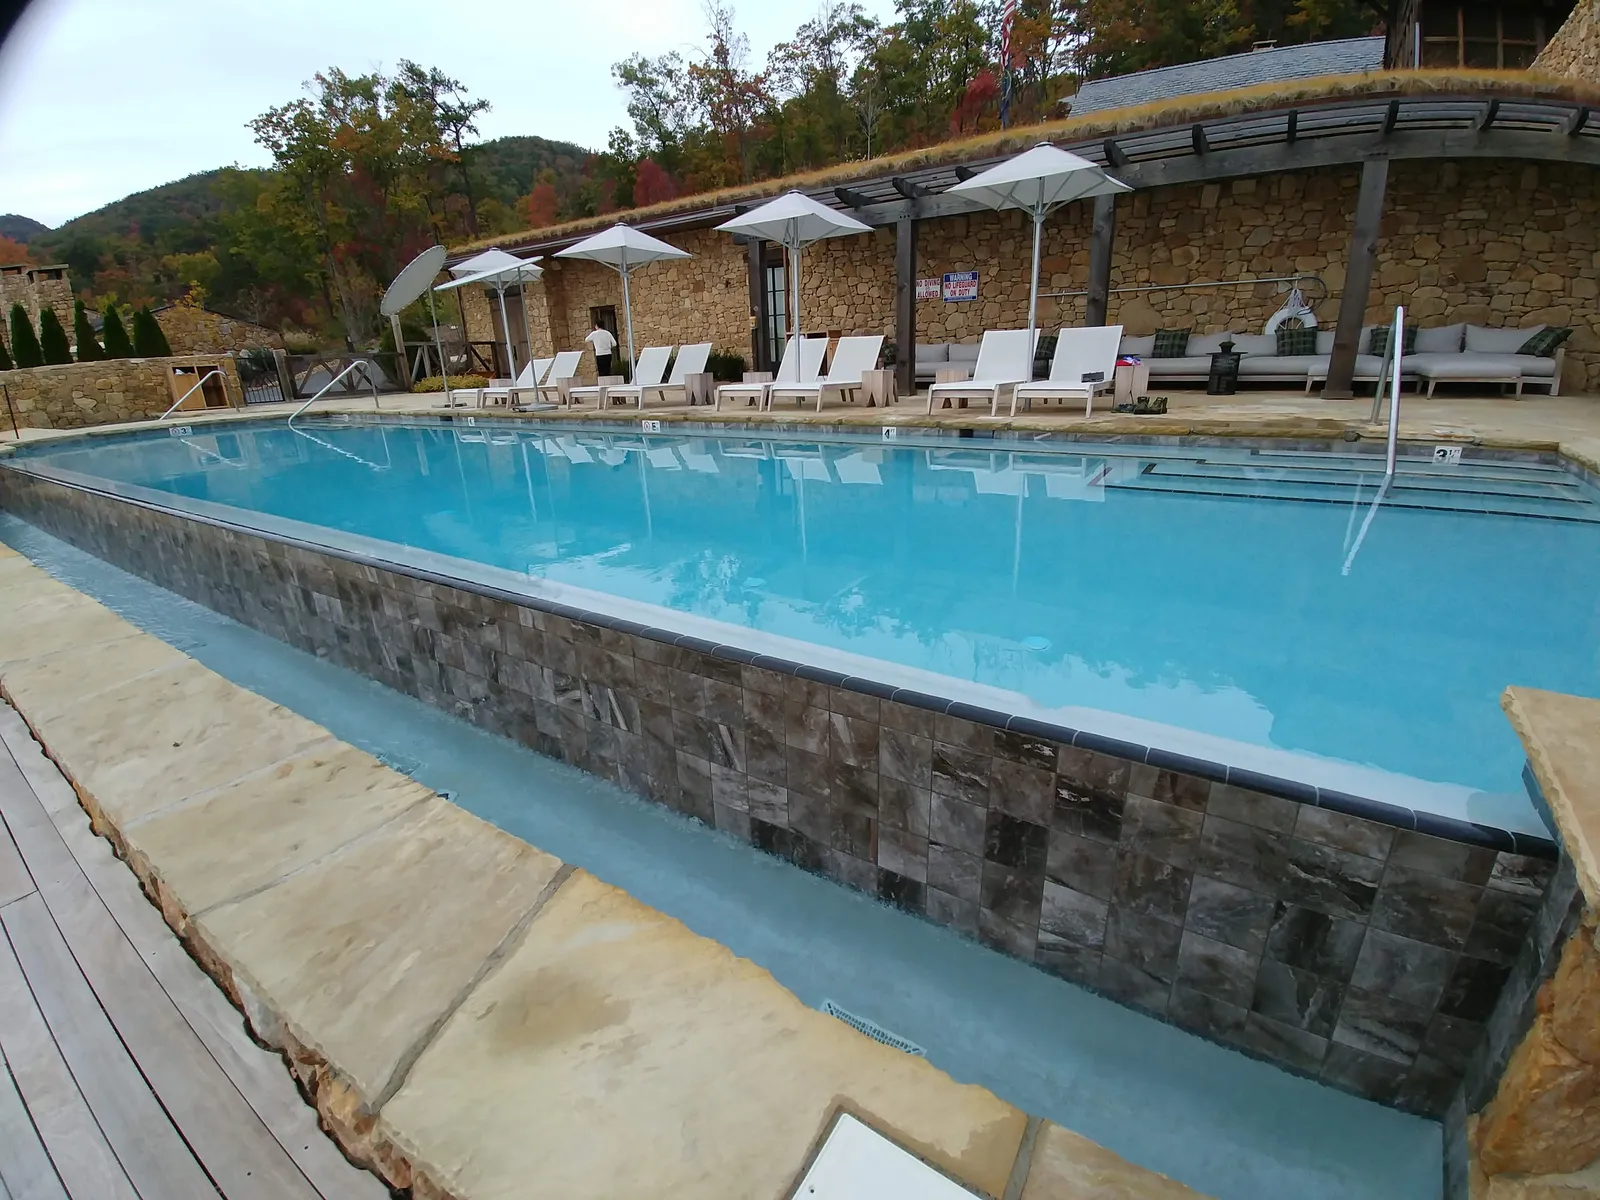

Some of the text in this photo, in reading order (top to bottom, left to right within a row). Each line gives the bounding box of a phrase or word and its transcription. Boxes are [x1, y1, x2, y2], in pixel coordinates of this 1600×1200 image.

[950, 273, 972, 281] WARNING
[925, 278, 940, 286] DIVING
[952, 280, 976, 289] LIFEGUARD
[917, 290, 938, 298] ALLOWED
